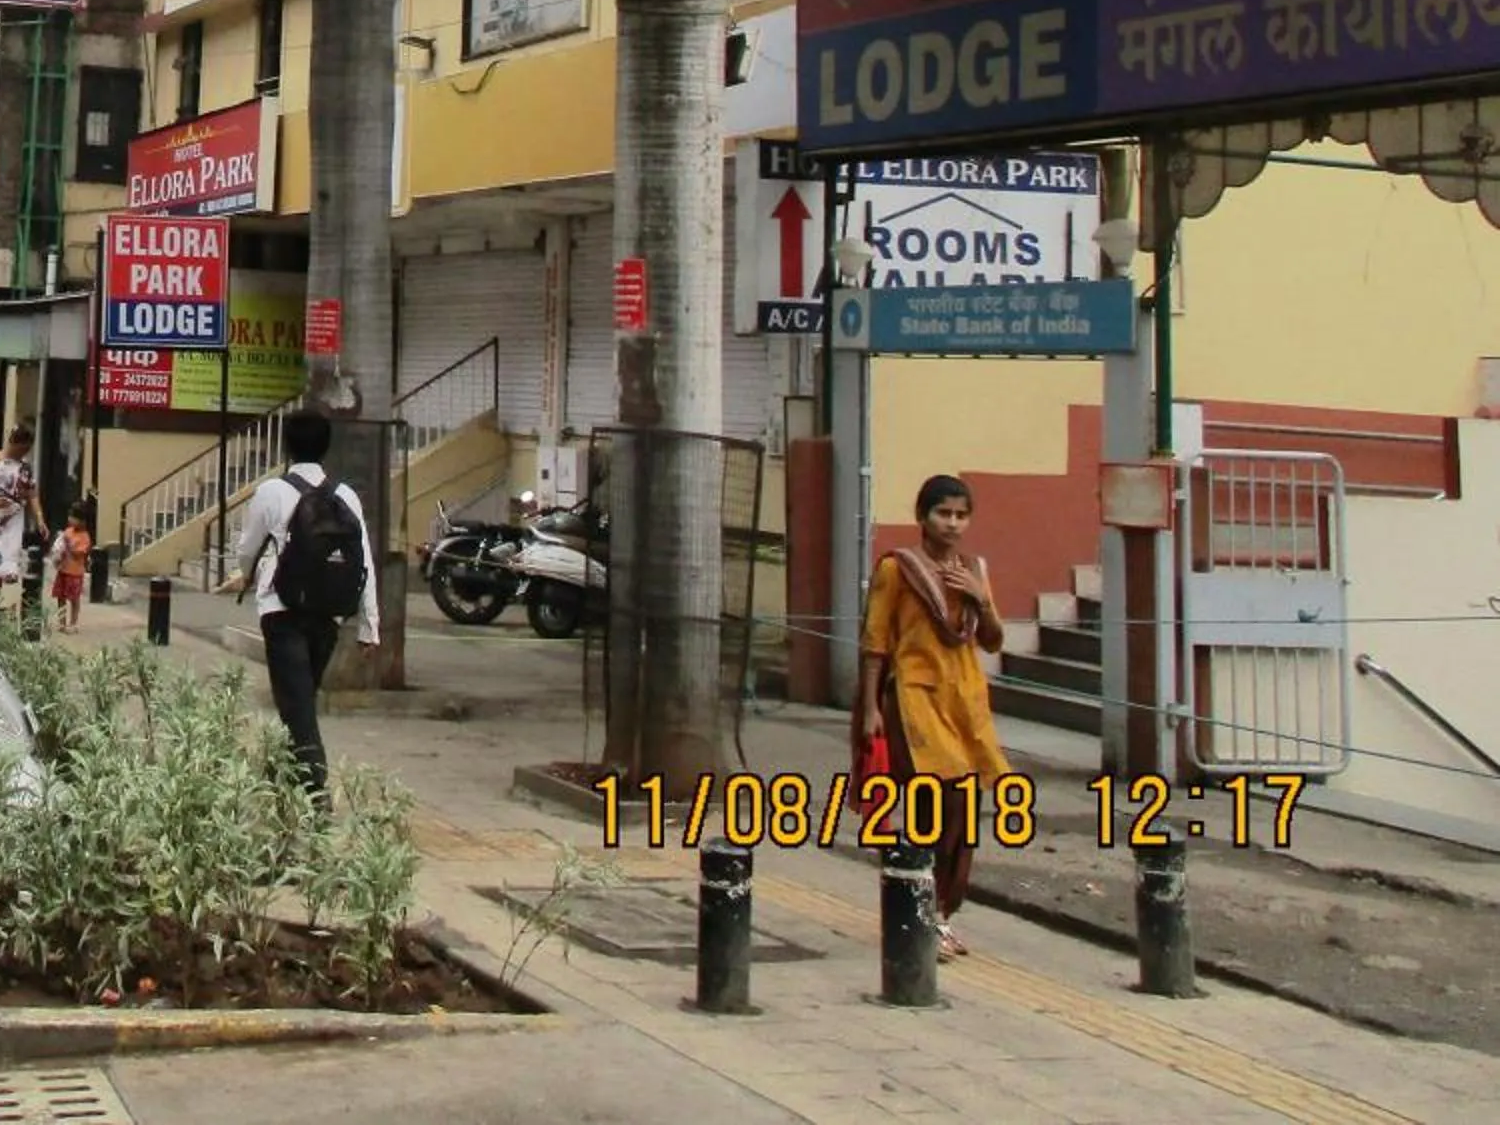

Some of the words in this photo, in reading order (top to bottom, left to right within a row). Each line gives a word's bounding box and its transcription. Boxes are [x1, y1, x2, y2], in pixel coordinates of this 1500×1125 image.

[819, 9, 1067, 126] LODGE
[172, 142, 203, 163] HOTEL
[130, 169, 195, 208] ELLORA
[200, 153, 256, 193] PARK
[881, 158, 999, 184] ELLORA
[1006, 158, 1089, 189] PARK
[114, 225, 220, 258] ELLORA
[869, 226, 1041, 266] ROOMS
[130, 263, 204, 296] PARK
[118, 302, 215, 337] LODGE
[767, 307, 808, 329] A/C
[900, 315, 949, 335] State
[955, 315, 1005, 335] Bank
[1011, 315, 1031, 335] of
[1038, 313, 1091, 335] India
